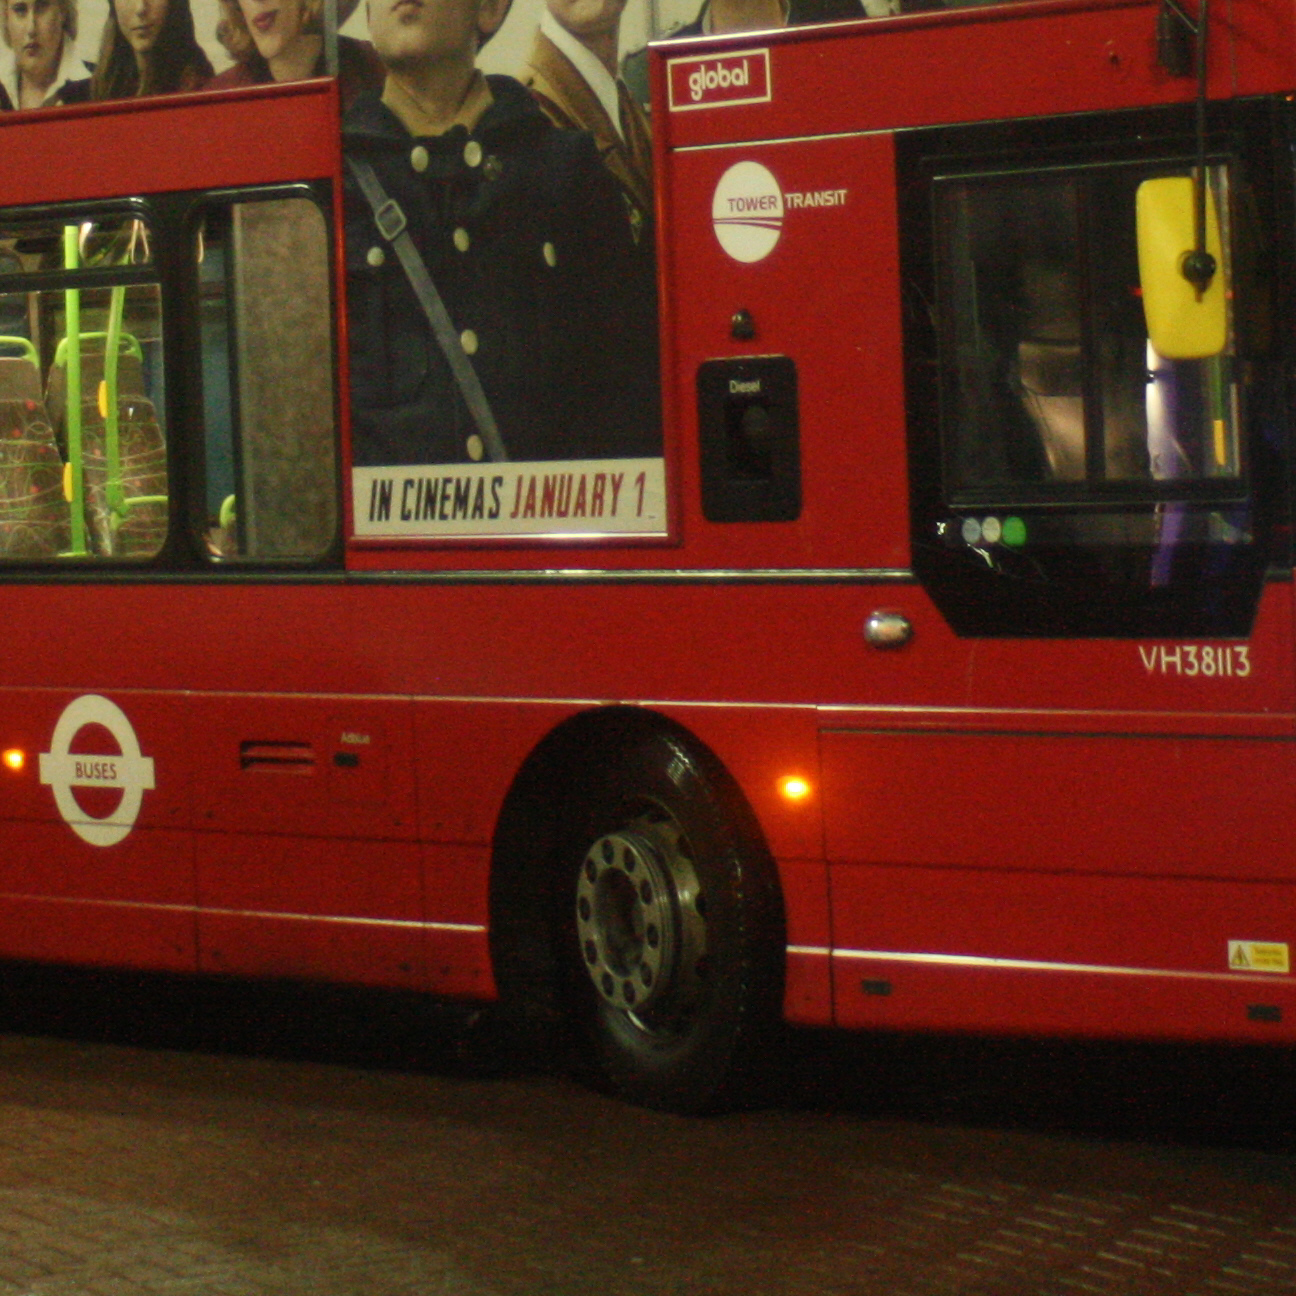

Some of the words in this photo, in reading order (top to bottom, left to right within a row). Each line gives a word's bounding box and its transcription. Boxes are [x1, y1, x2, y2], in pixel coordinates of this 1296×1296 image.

[689, 59, 749, 102] global
[727, 194, 778, 212] TOWER
[784, 189, 848, 209] TRANSIT
[729, 380, 760, 394] Diesel
[368, 479, 394, 522] IN
[400, 476, 504, 522] CINEMAS
[510, 472, 625, 519] JANUARY
[635, 471, 647, 518] 1
[1138, 645, 1252, 678] VH38113
[75, 761, 117, 780] BUSES
